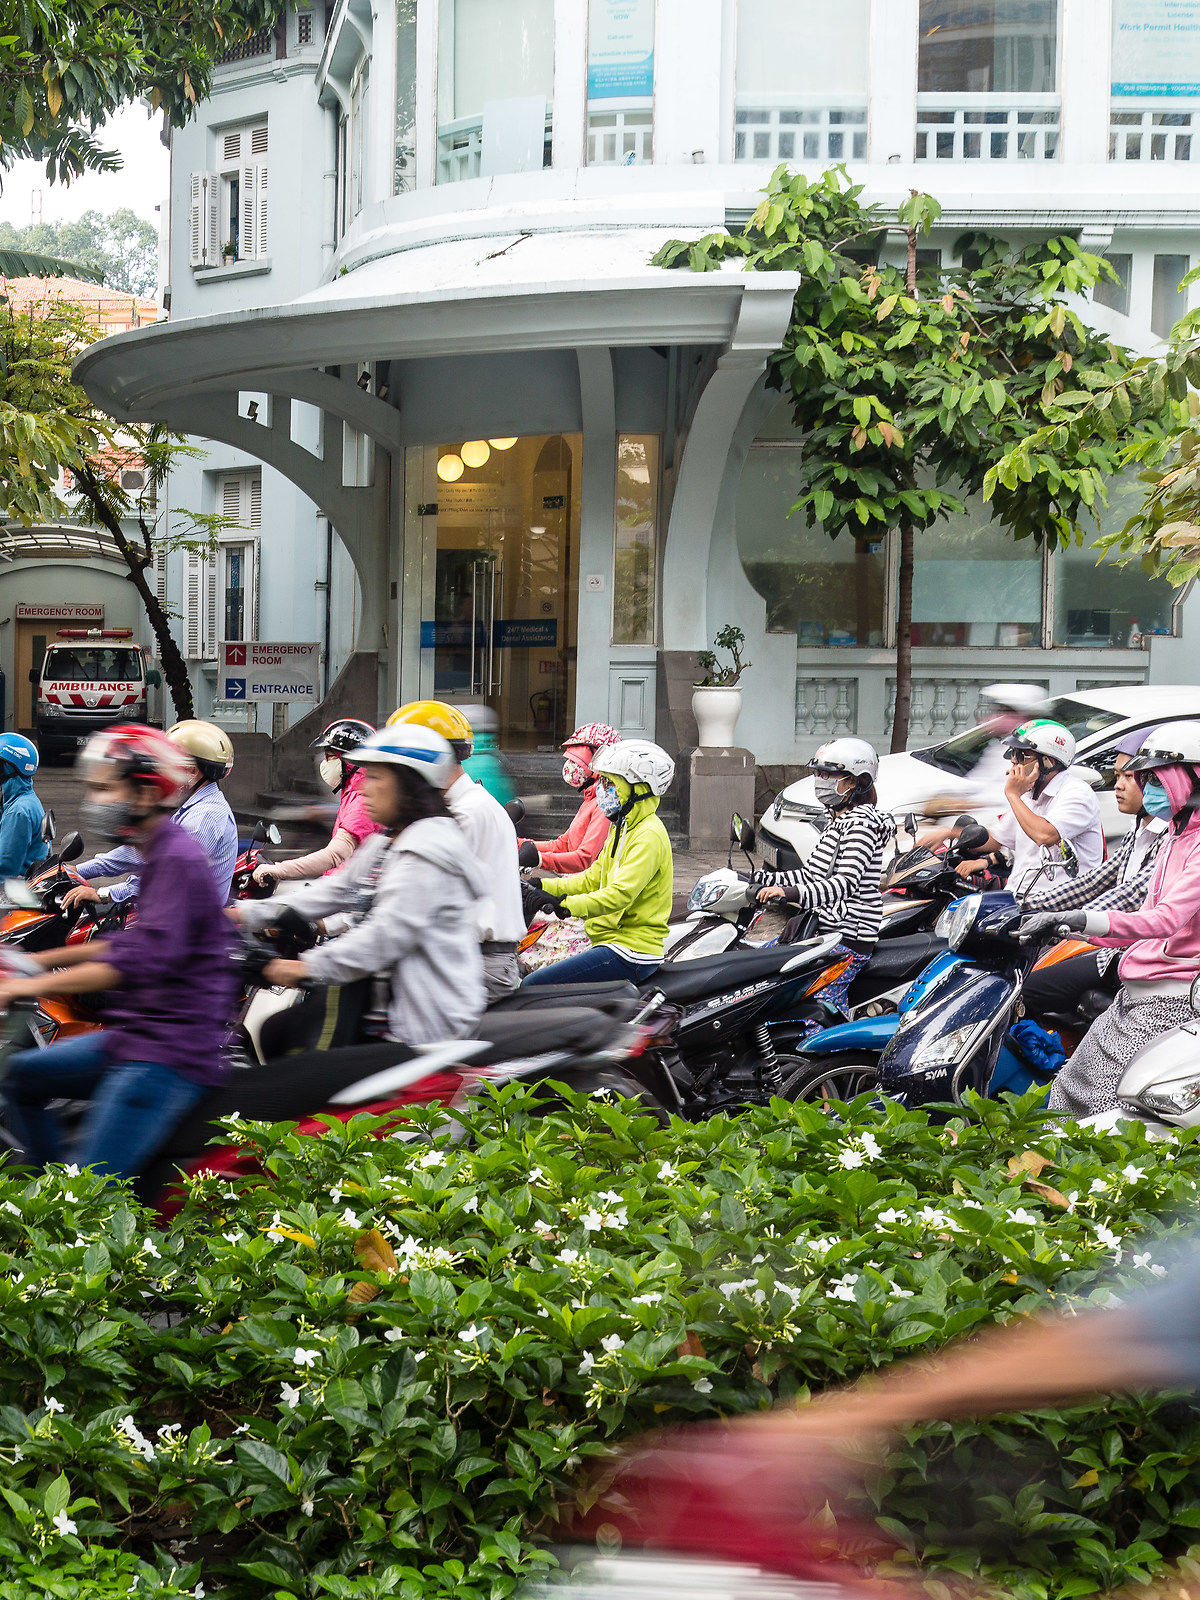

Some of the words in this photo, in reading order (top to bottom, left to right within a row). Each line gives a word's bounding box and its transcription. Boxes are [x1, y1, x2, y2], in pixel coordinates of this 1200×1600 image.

[1119, 23, 1141, 31] Work
[1143, 23, 1171, 31] Permit
[18, 608, 73, 616] EMERGENCY
[75, 608, 102, 616] ROOM
[521, 634, 555, 642] Assistance
[252, 645, 315, 655] EMERGENCY
[252, 656, 282, 665] ROOM
[48, 682, 135, 692] AMBULANCE
[252, 684, 314, 695] ENTRANCE
[924, 1068, 948, 1081] SYM
